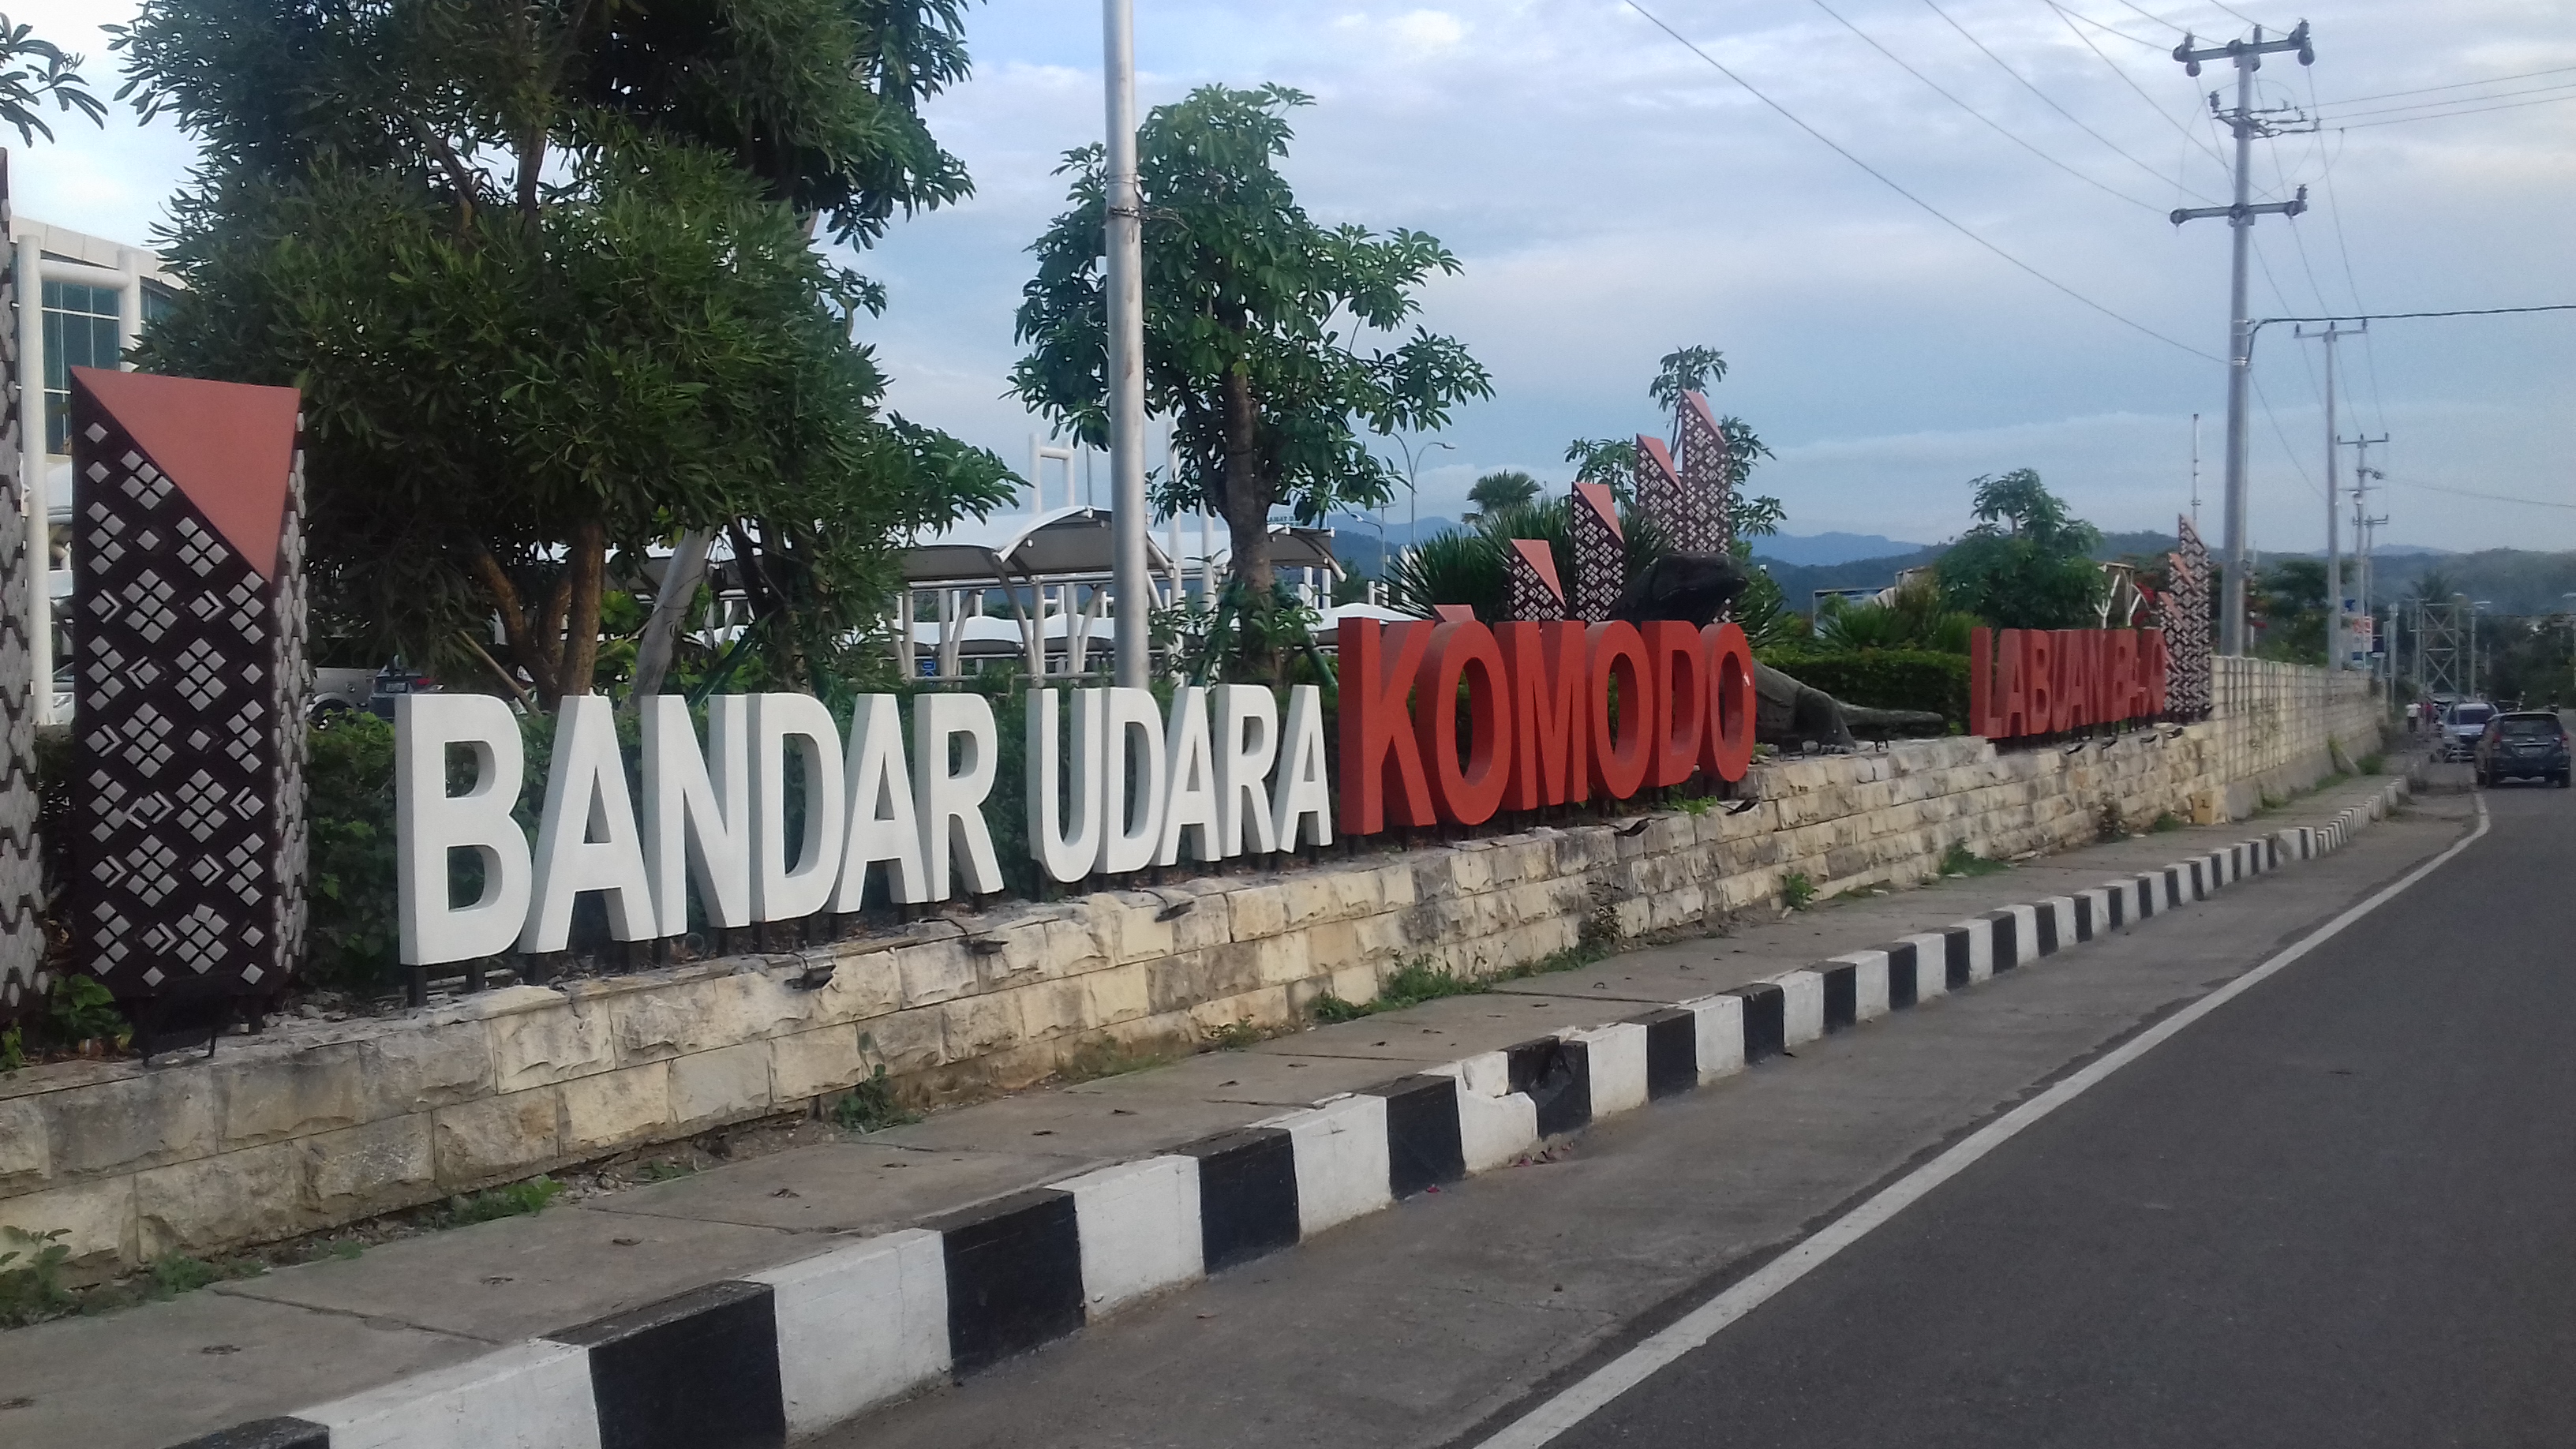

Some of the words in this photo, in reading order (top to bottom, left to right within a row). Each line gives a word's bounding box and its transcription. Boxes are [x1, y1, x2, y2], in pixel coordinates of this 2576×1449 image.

[396, 692, 1005, 965] BANDAR
[1026, 683, 1333, 882] UDARA
[1339, 617, 1757, 835] KOMODO
[1970, 627, 2106, 738] LABUAN
